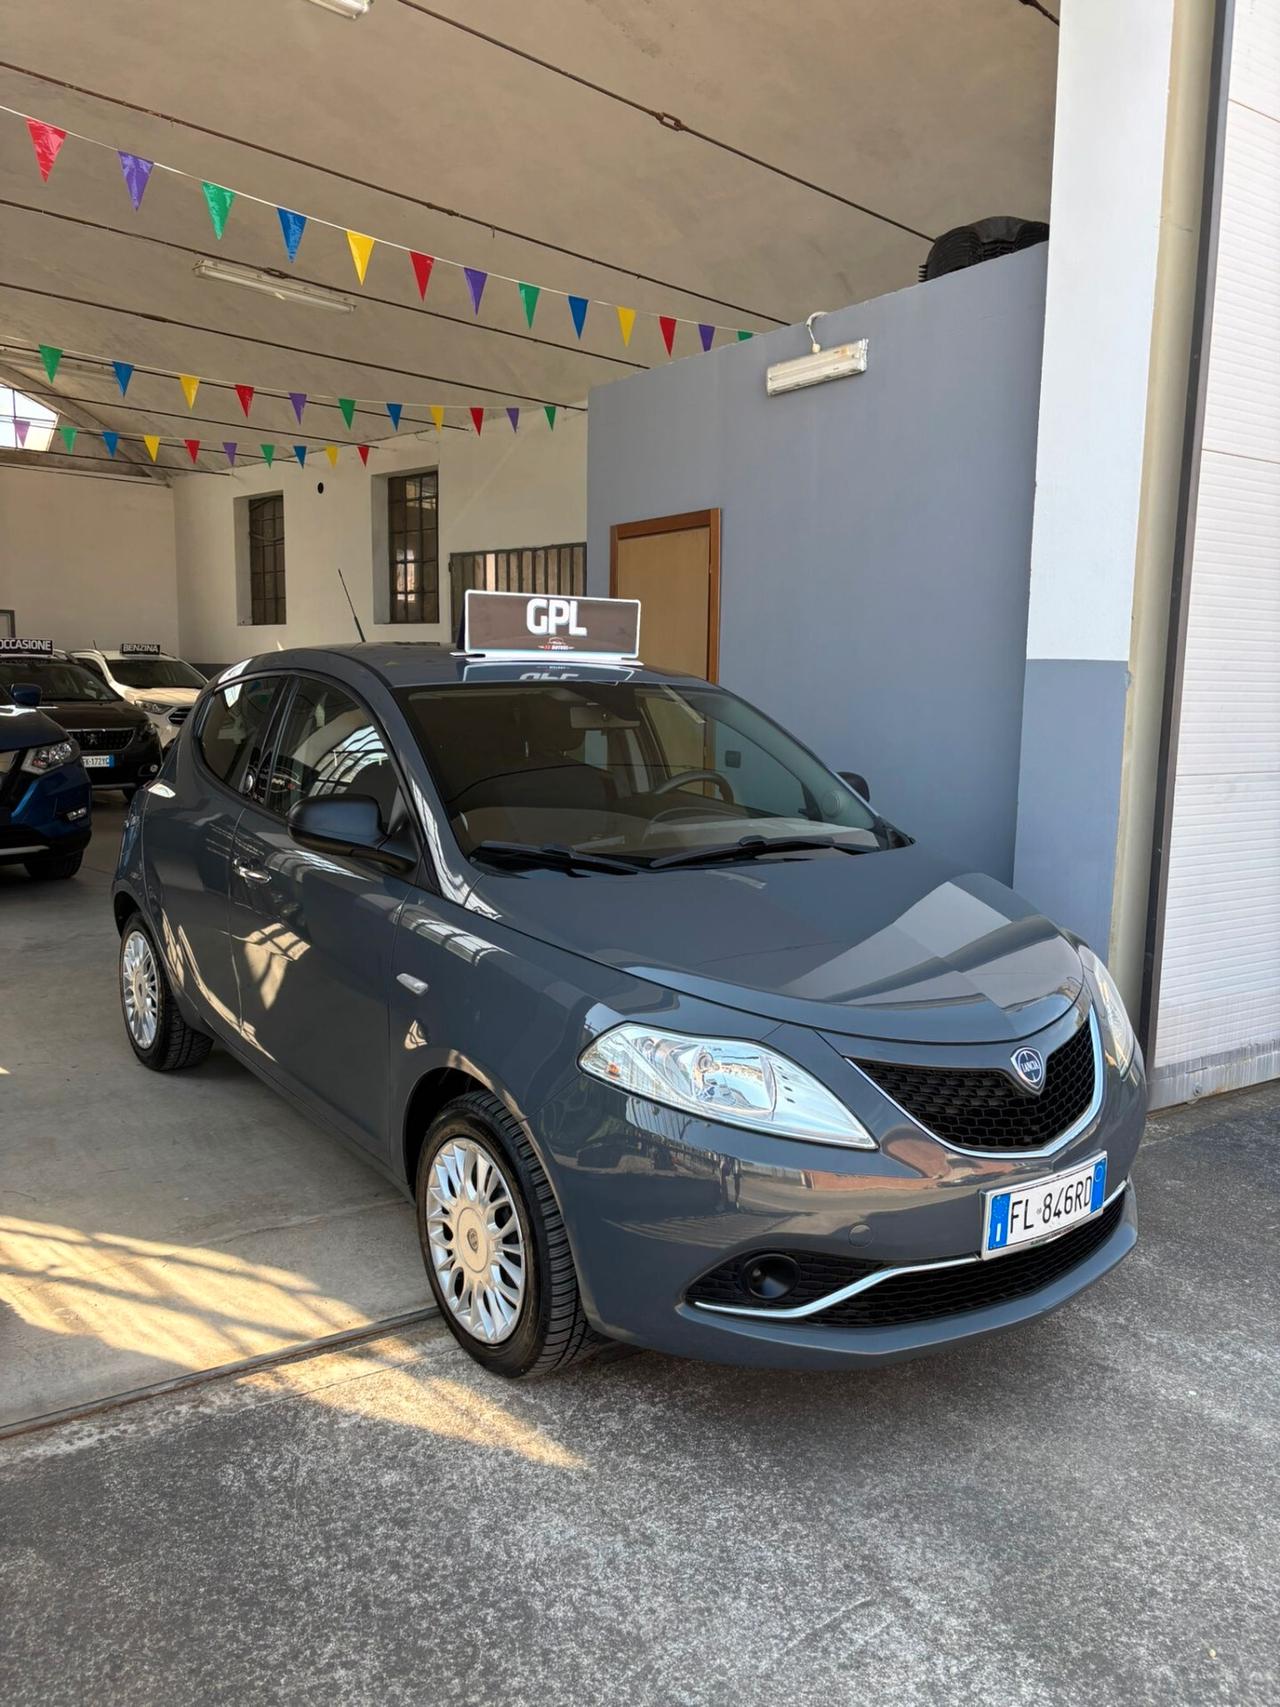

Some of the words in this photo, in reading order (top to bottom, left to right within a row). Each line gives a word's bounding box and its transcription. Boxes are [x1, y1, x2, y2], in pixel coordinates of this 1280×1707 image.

[526, 598, 588, 636] GPL
[0, 639, 52, 651] OCCASIONE
[123, 643, 159, 653] BENZINA
[1020, 1059, 1041, 1073] LANCIA
[1010, 1199, 1034, 1234] FL
[1042, 1175, 1093, 1224] 846RD
